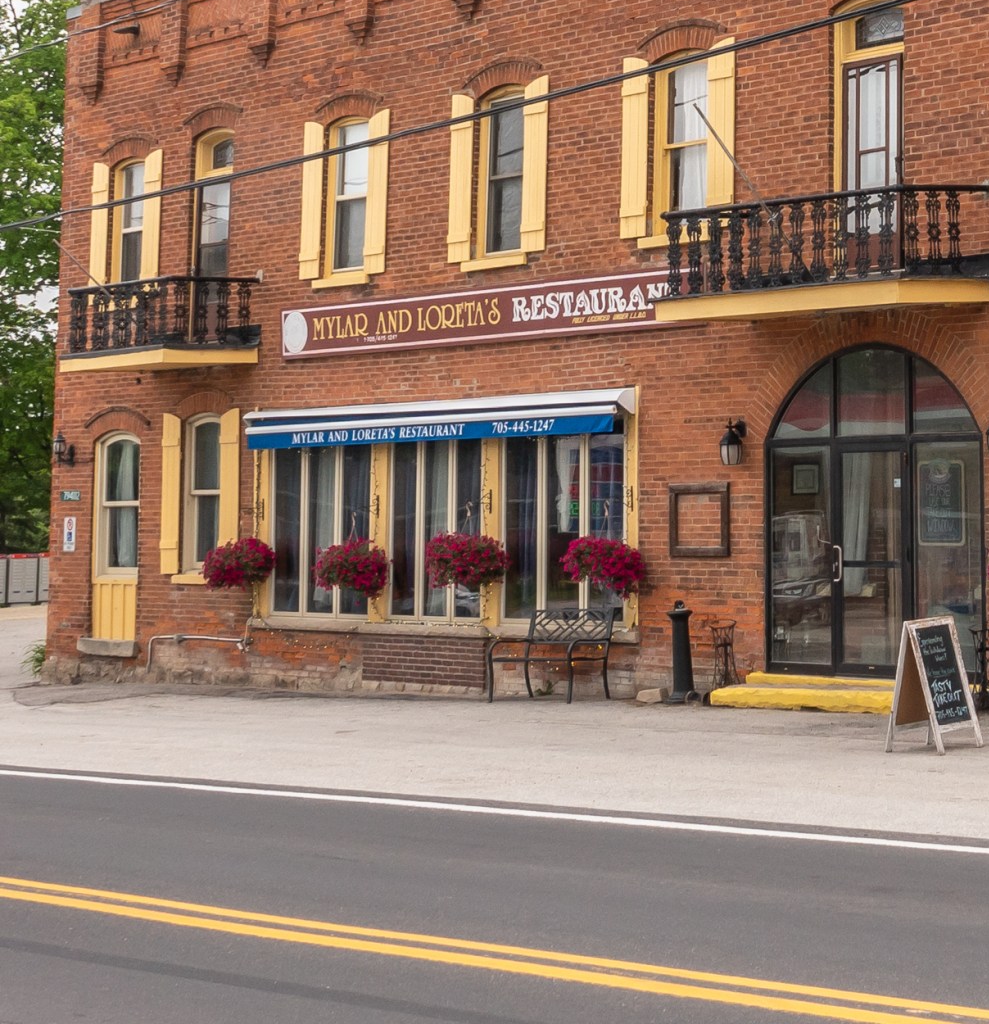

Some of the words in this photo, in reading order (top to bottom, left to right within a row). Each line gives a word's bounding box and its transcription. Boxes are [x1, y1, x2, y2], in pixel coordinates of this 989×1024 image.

[312, 313, 368, 340] MYLAR
[375, 309, 412, 335] AND
[417, 297, 501, 332] LORETA'S
[292, 432, 325, 444] MYLAR
[328, 430, 348, 442] AND
[352, 427, 396, 441] LORETA'S
[399, 423, 465, 439] RESTAURANT
[491, 419, 555, 434] 705-445-1247
[931, 679, 952, 694] TASTY
